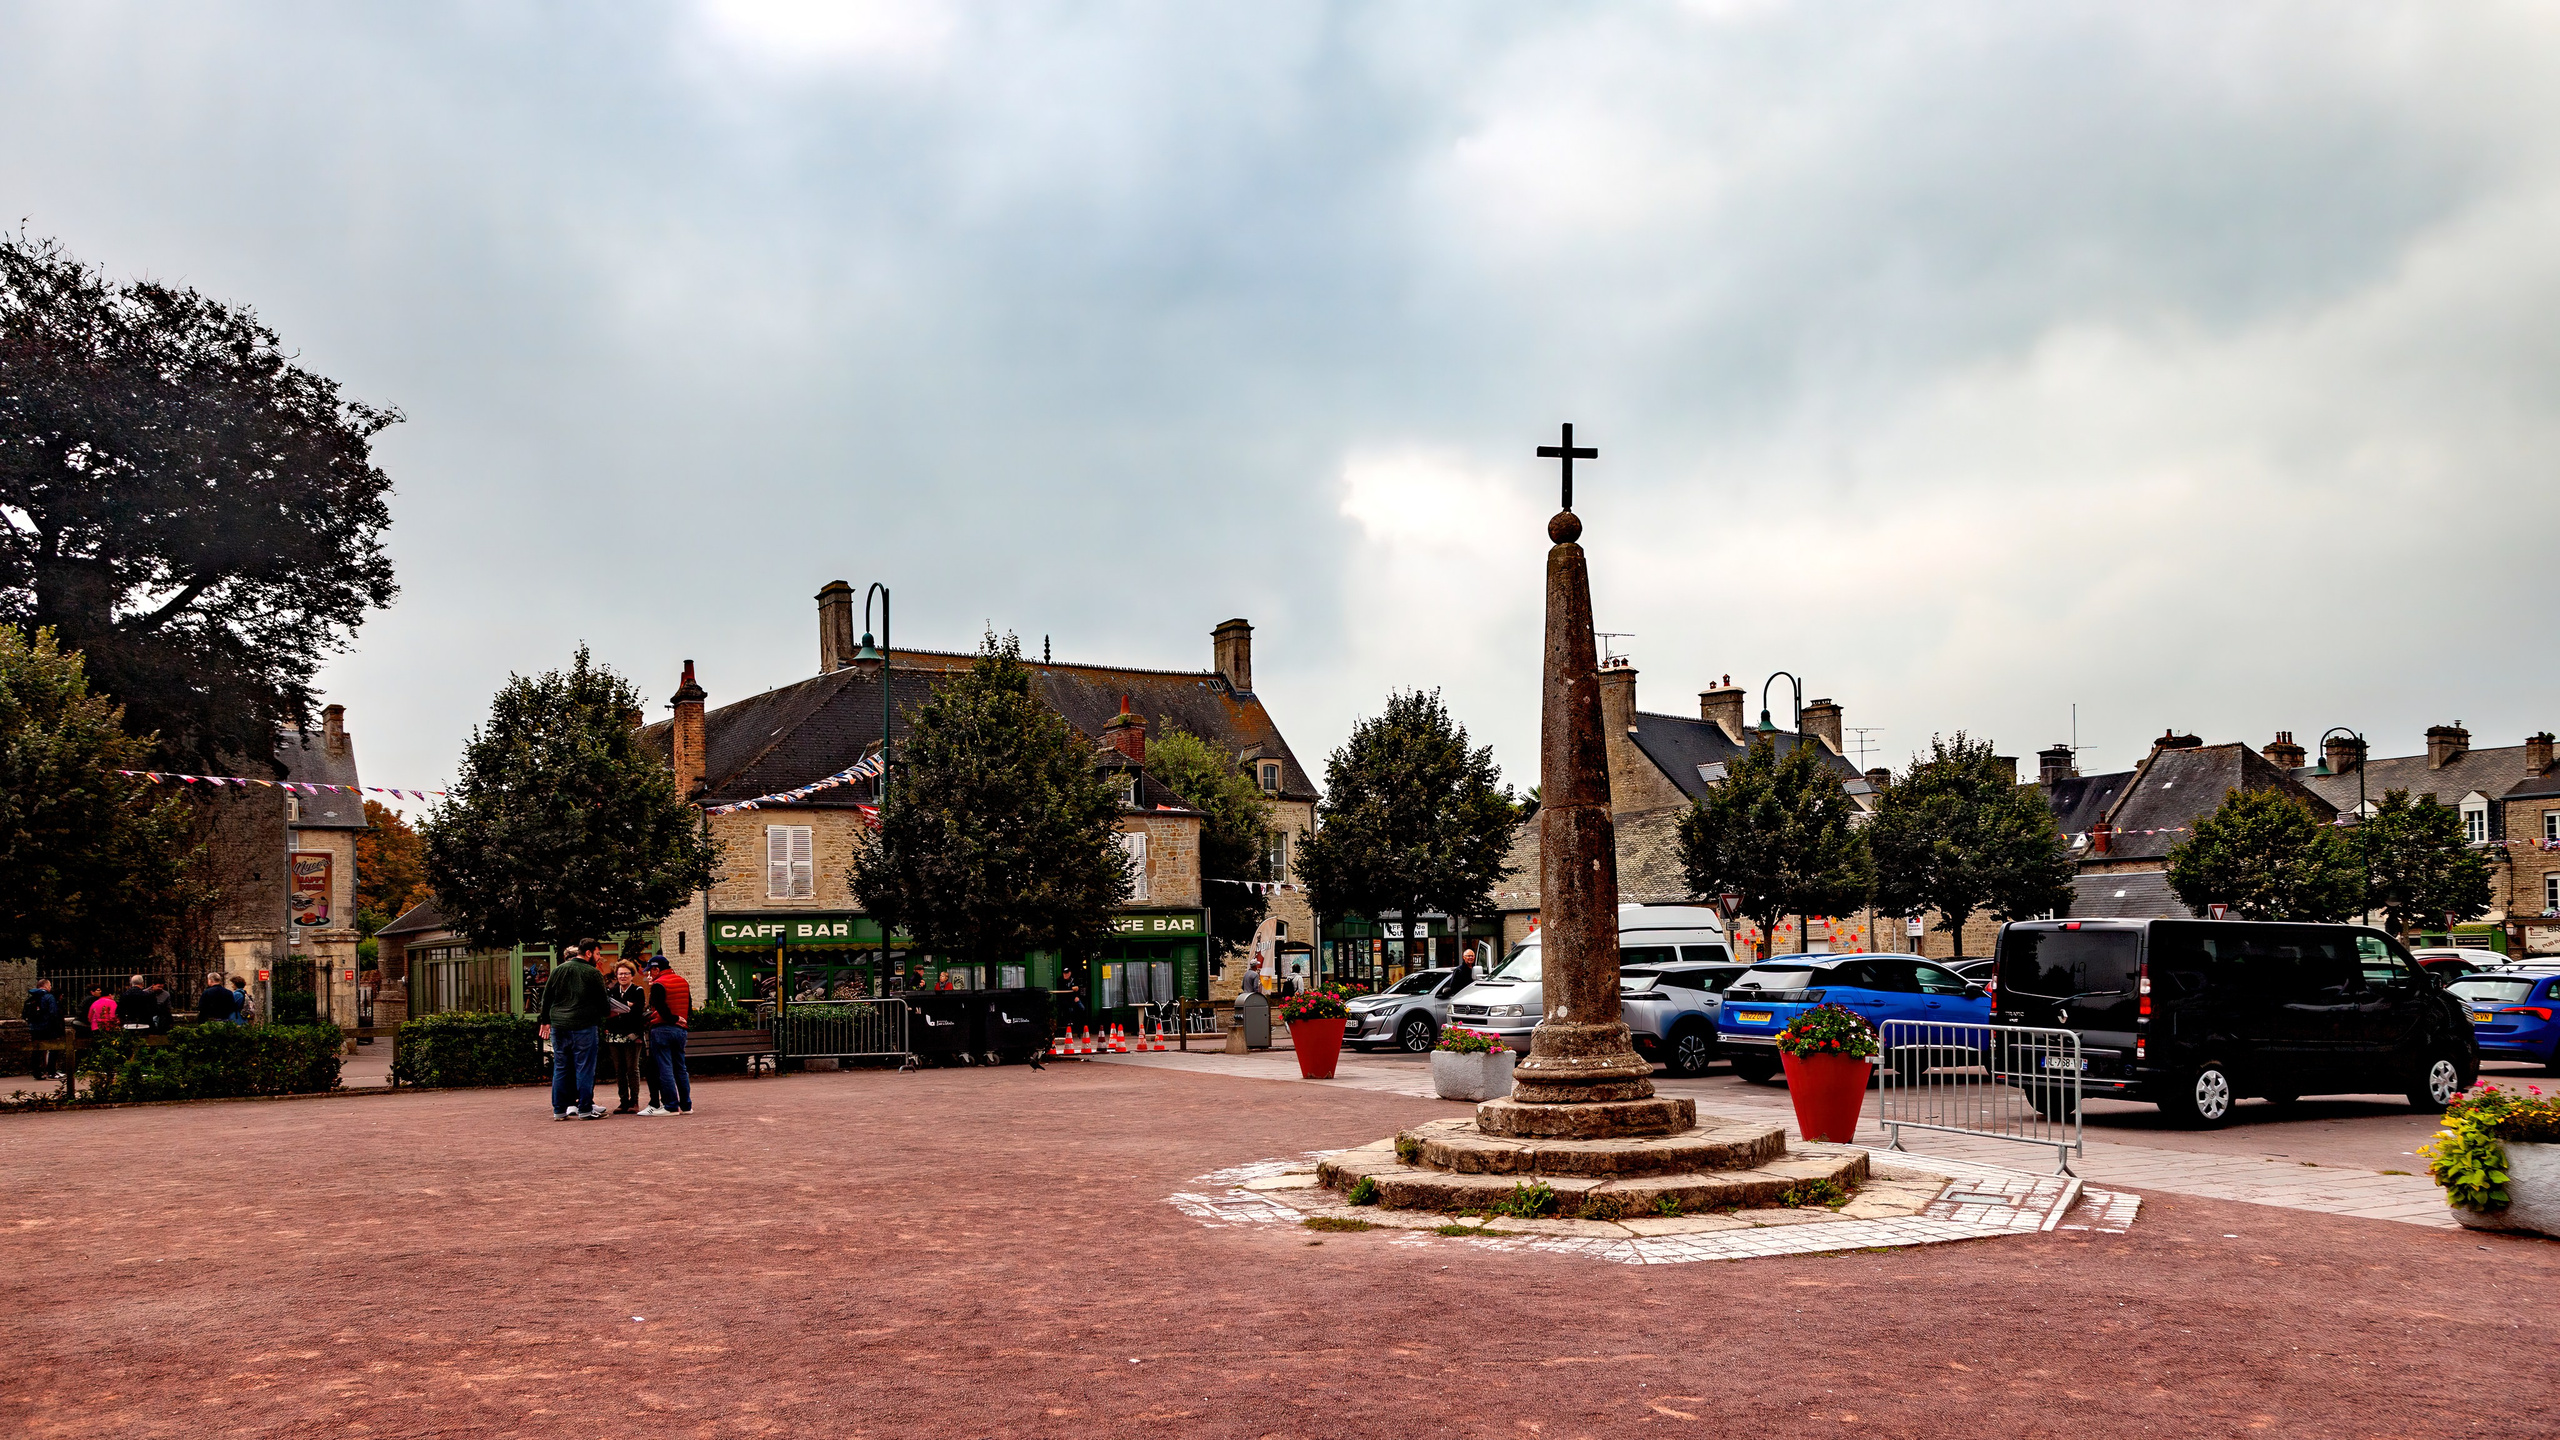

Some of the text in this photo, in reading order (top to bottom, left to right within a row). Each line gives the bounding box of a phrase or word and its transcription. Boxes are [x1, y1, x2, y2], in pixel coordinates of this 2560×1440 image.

[797, 924, 848, 937] BAR
[1154, 919, 1195, 931] BAR
[717, 960, 736, 989] CARTES
